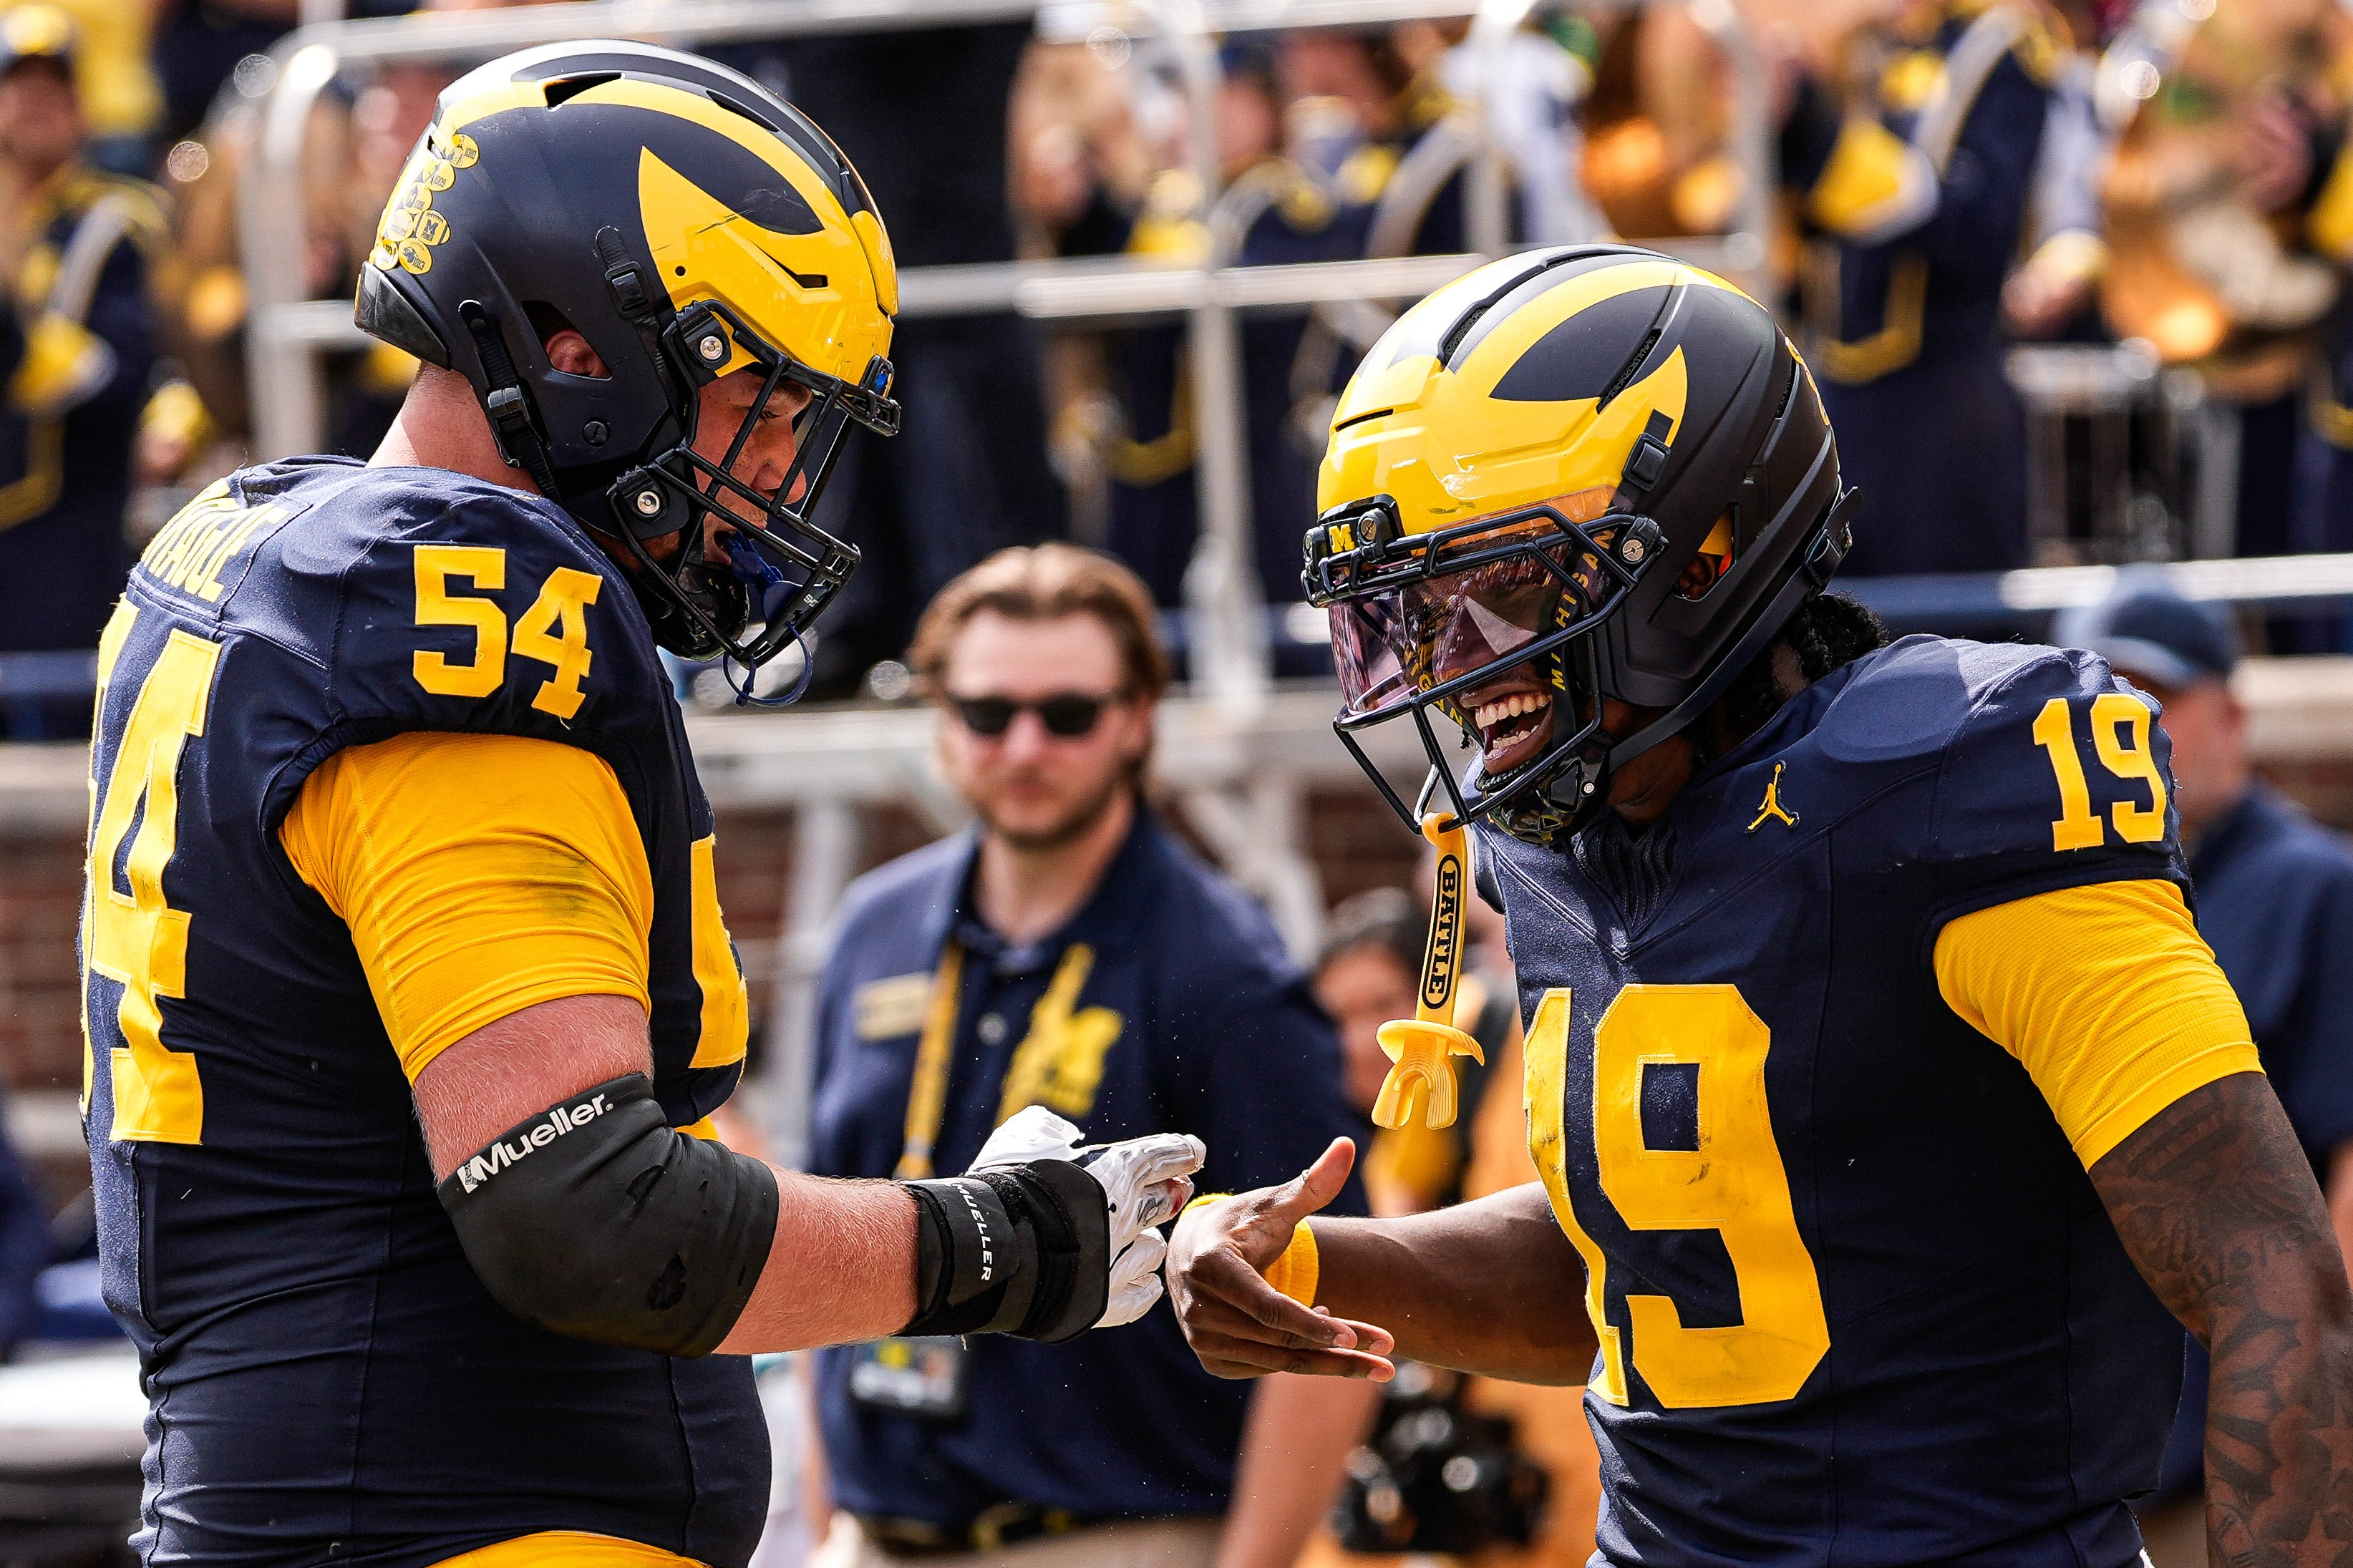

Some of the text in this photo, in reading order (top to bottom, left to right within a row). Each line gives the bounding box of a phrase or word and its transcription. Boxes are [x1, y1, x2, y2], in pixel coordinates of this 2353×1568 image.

[424, 219, 438, 235] M
[1329, 524, 1355, 553] M
[413, 545, 603, 719] 54
[1551, 530, 1615, 691] MIHIGAN
[2033, 693, 2167, 852] 19
[80, 593, 221, 1145] 4
[1428, 869, 1456, 995] BATTLE
[469, 1093, 605, 1182] Mueller
[1523, 983, 1831, 1408] 19
[951, 1182, 993, 1281] MUELLER
